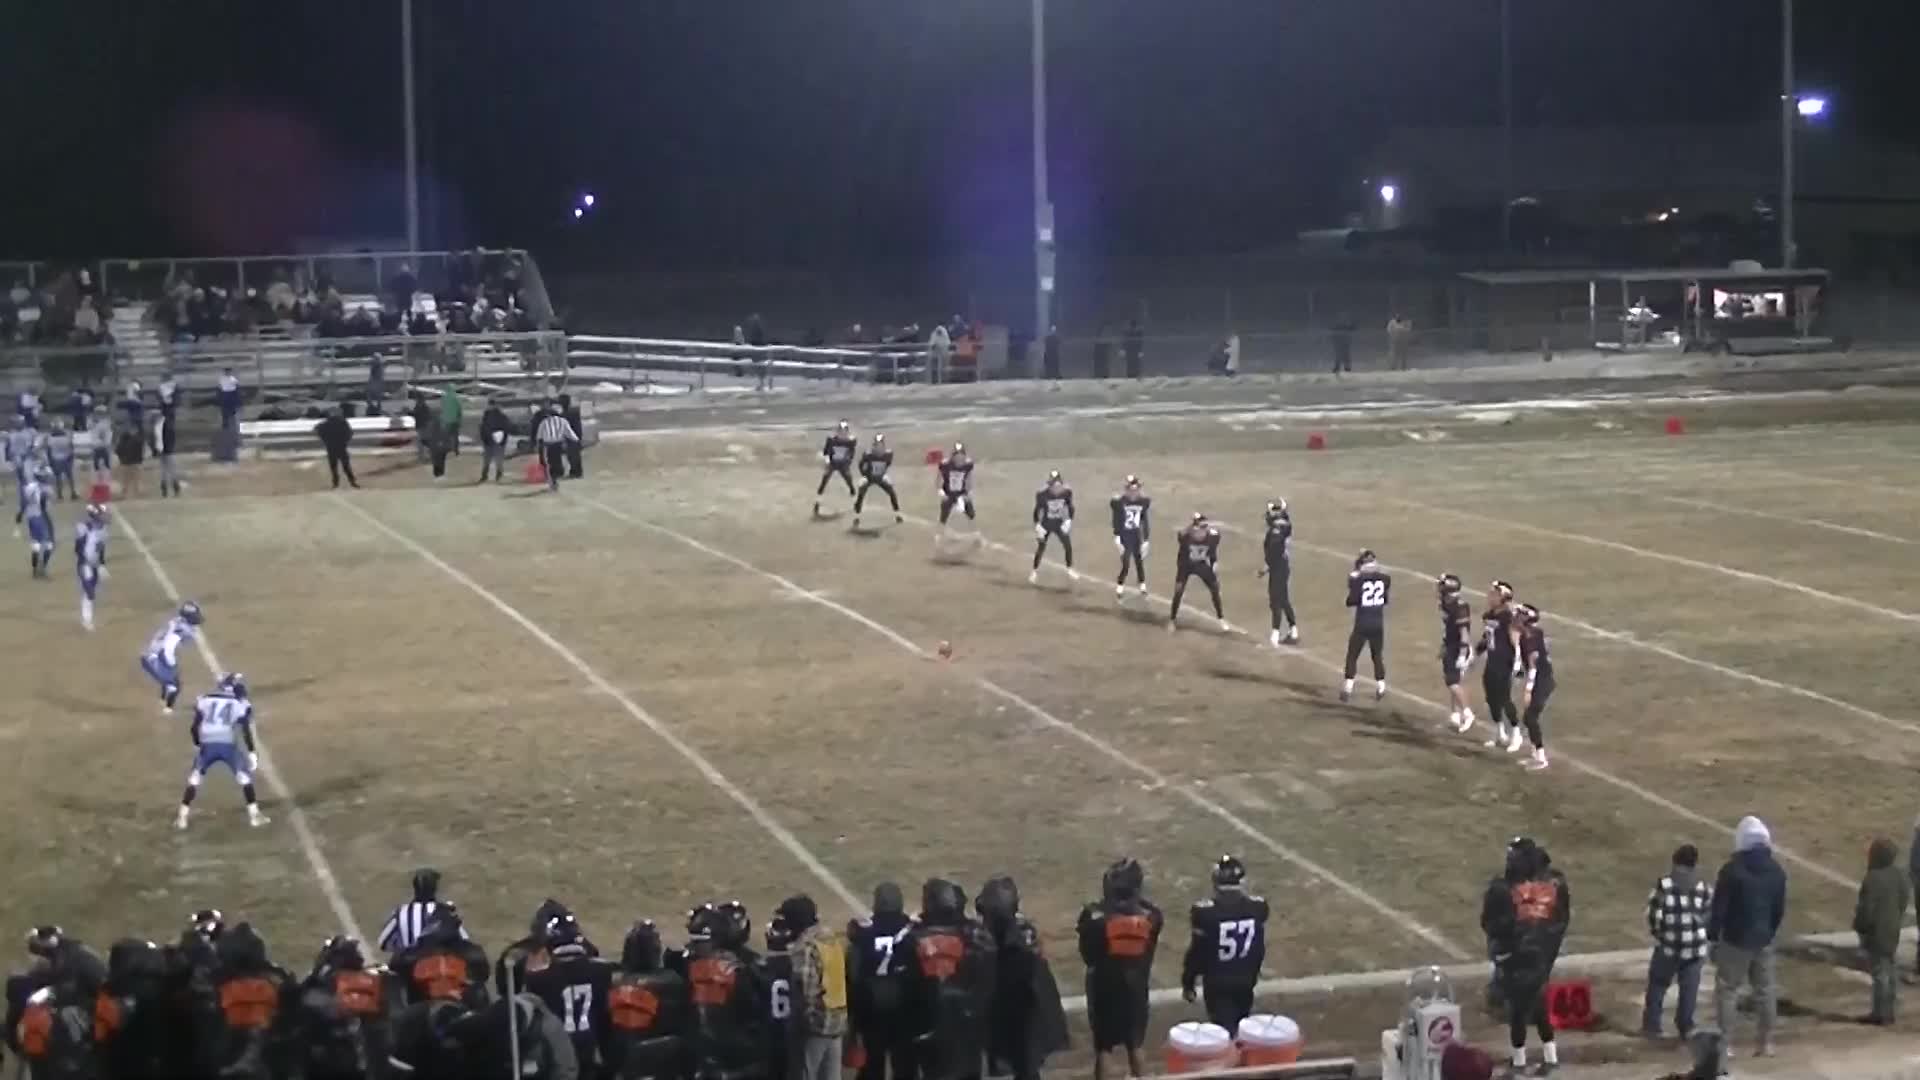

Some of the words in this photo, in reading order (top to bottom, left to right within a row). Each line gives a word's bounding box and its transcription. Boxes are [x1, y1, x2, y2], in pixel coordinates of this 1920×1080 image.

[1361, 580, 1385, 607] 22
[207, 701, 234, 725] 14
[874, 936, 894, 976] 7
[1218, 918, 1255, 961] 57
[562, 983, 592, 1033] 17
[771, 978, 791, 1018] 6
